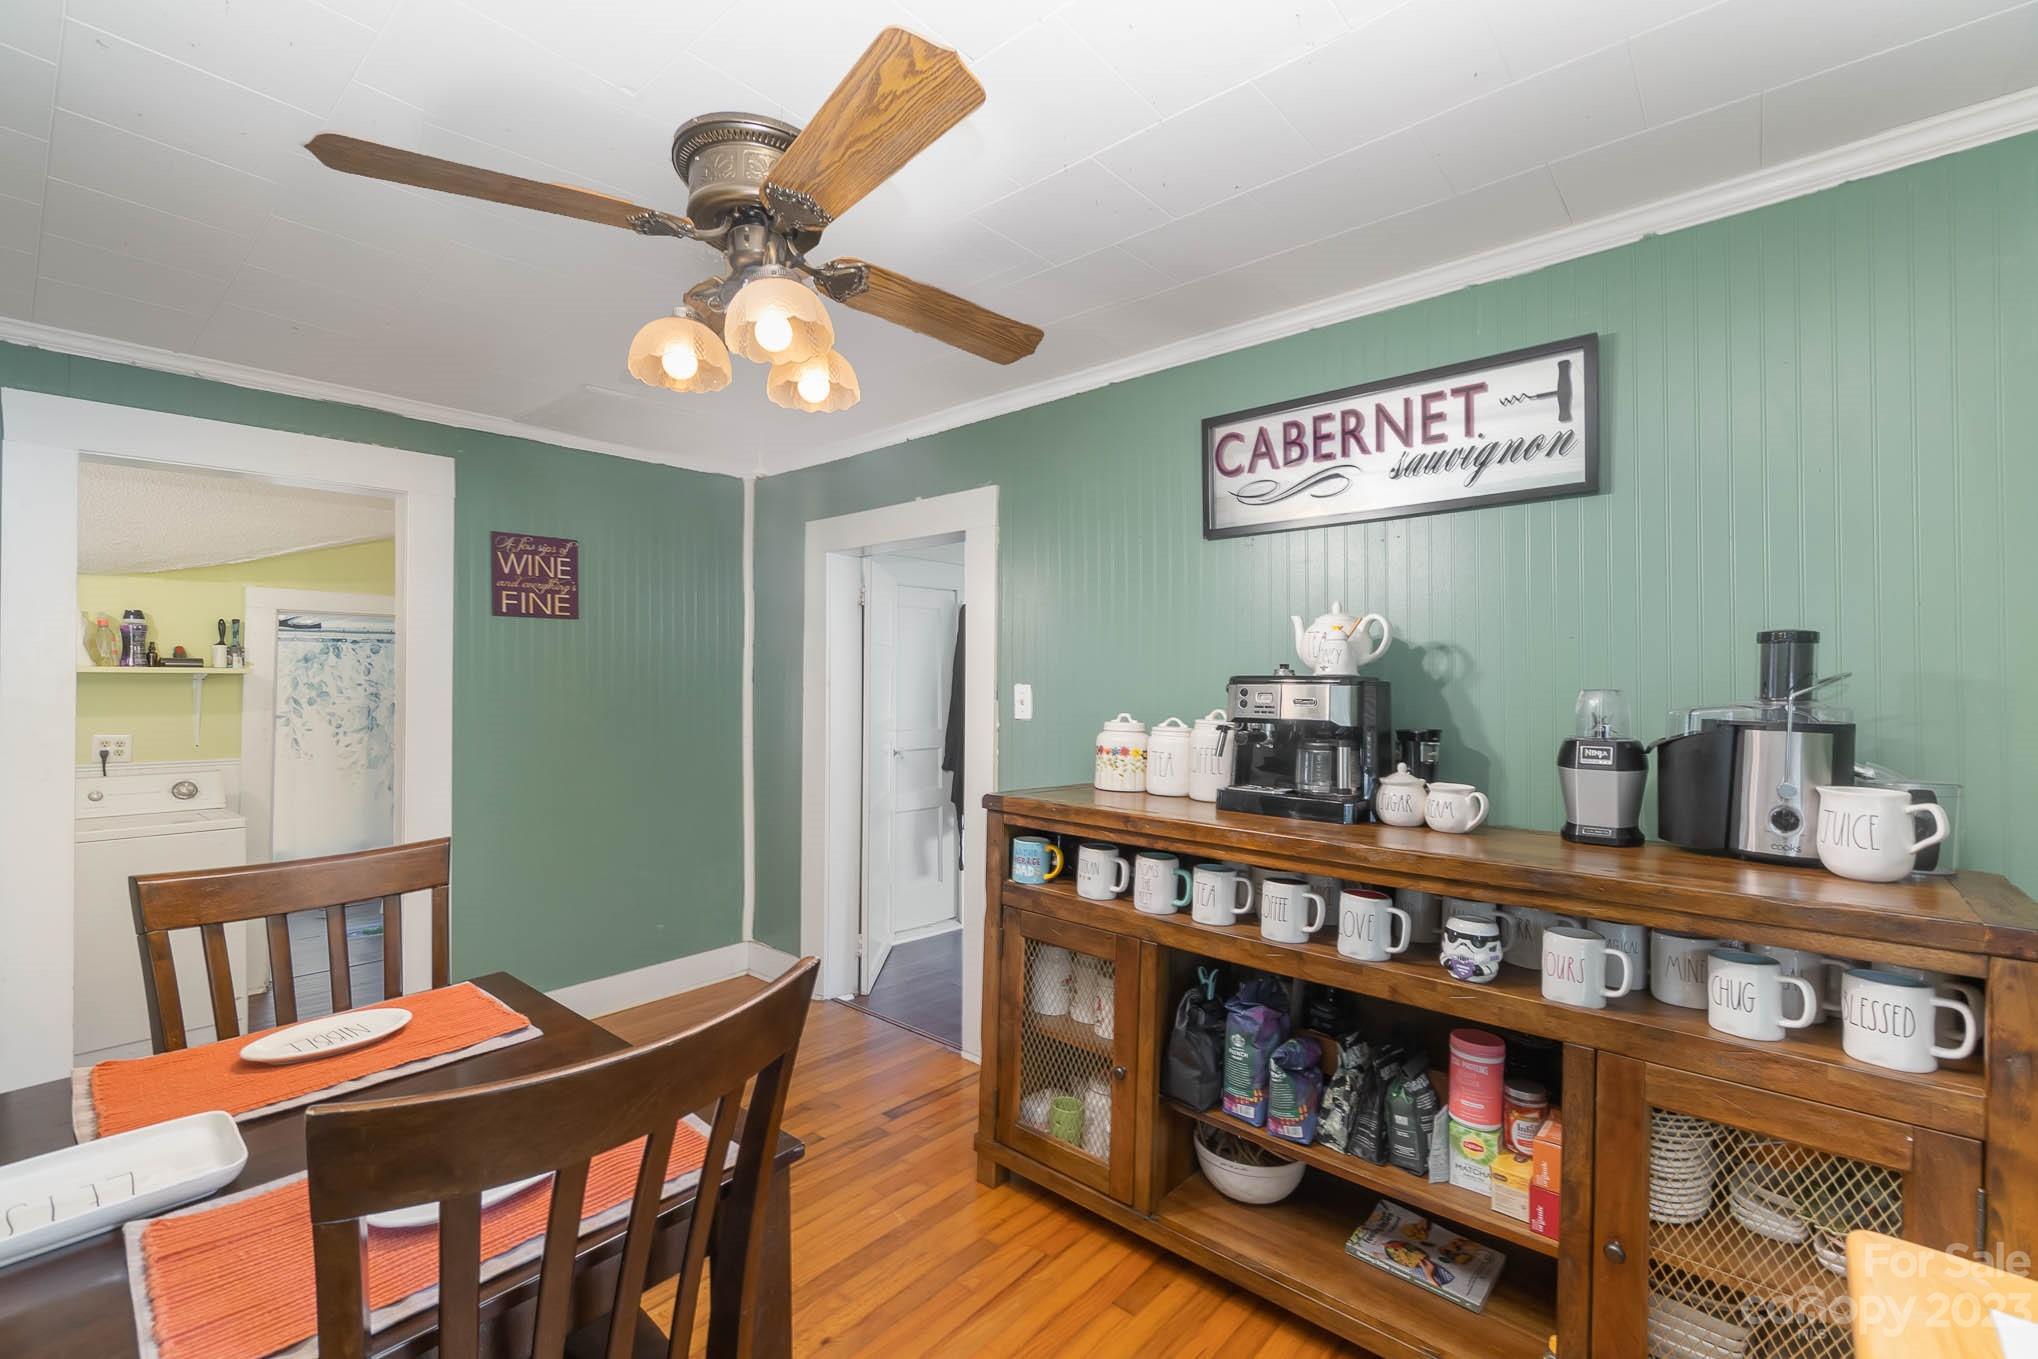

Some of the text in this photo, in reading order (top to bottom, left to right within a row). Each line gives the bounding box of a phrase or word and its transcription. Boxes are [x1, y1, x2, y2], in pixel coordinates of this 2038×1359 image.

[1214, 381, 1489, 478] CABERNET
[1388, 428, 1579, 488] sauvignon
[537, 543, 557, 557] sips
[559, 541, 579, 557] of
[496, 551, 571, 579] WINE
[496, 576, 522, 588] and
[502, 590, 570, 616] FINE
[1820, 808, 1881, 852] JUICE
[1770, 842, 1803, 854] cooks
[1195, 881, 1217, 908] TEA
[1339, 909, 1376, 942] OVE
[1711, 974, 1757, 1014] CHUG
